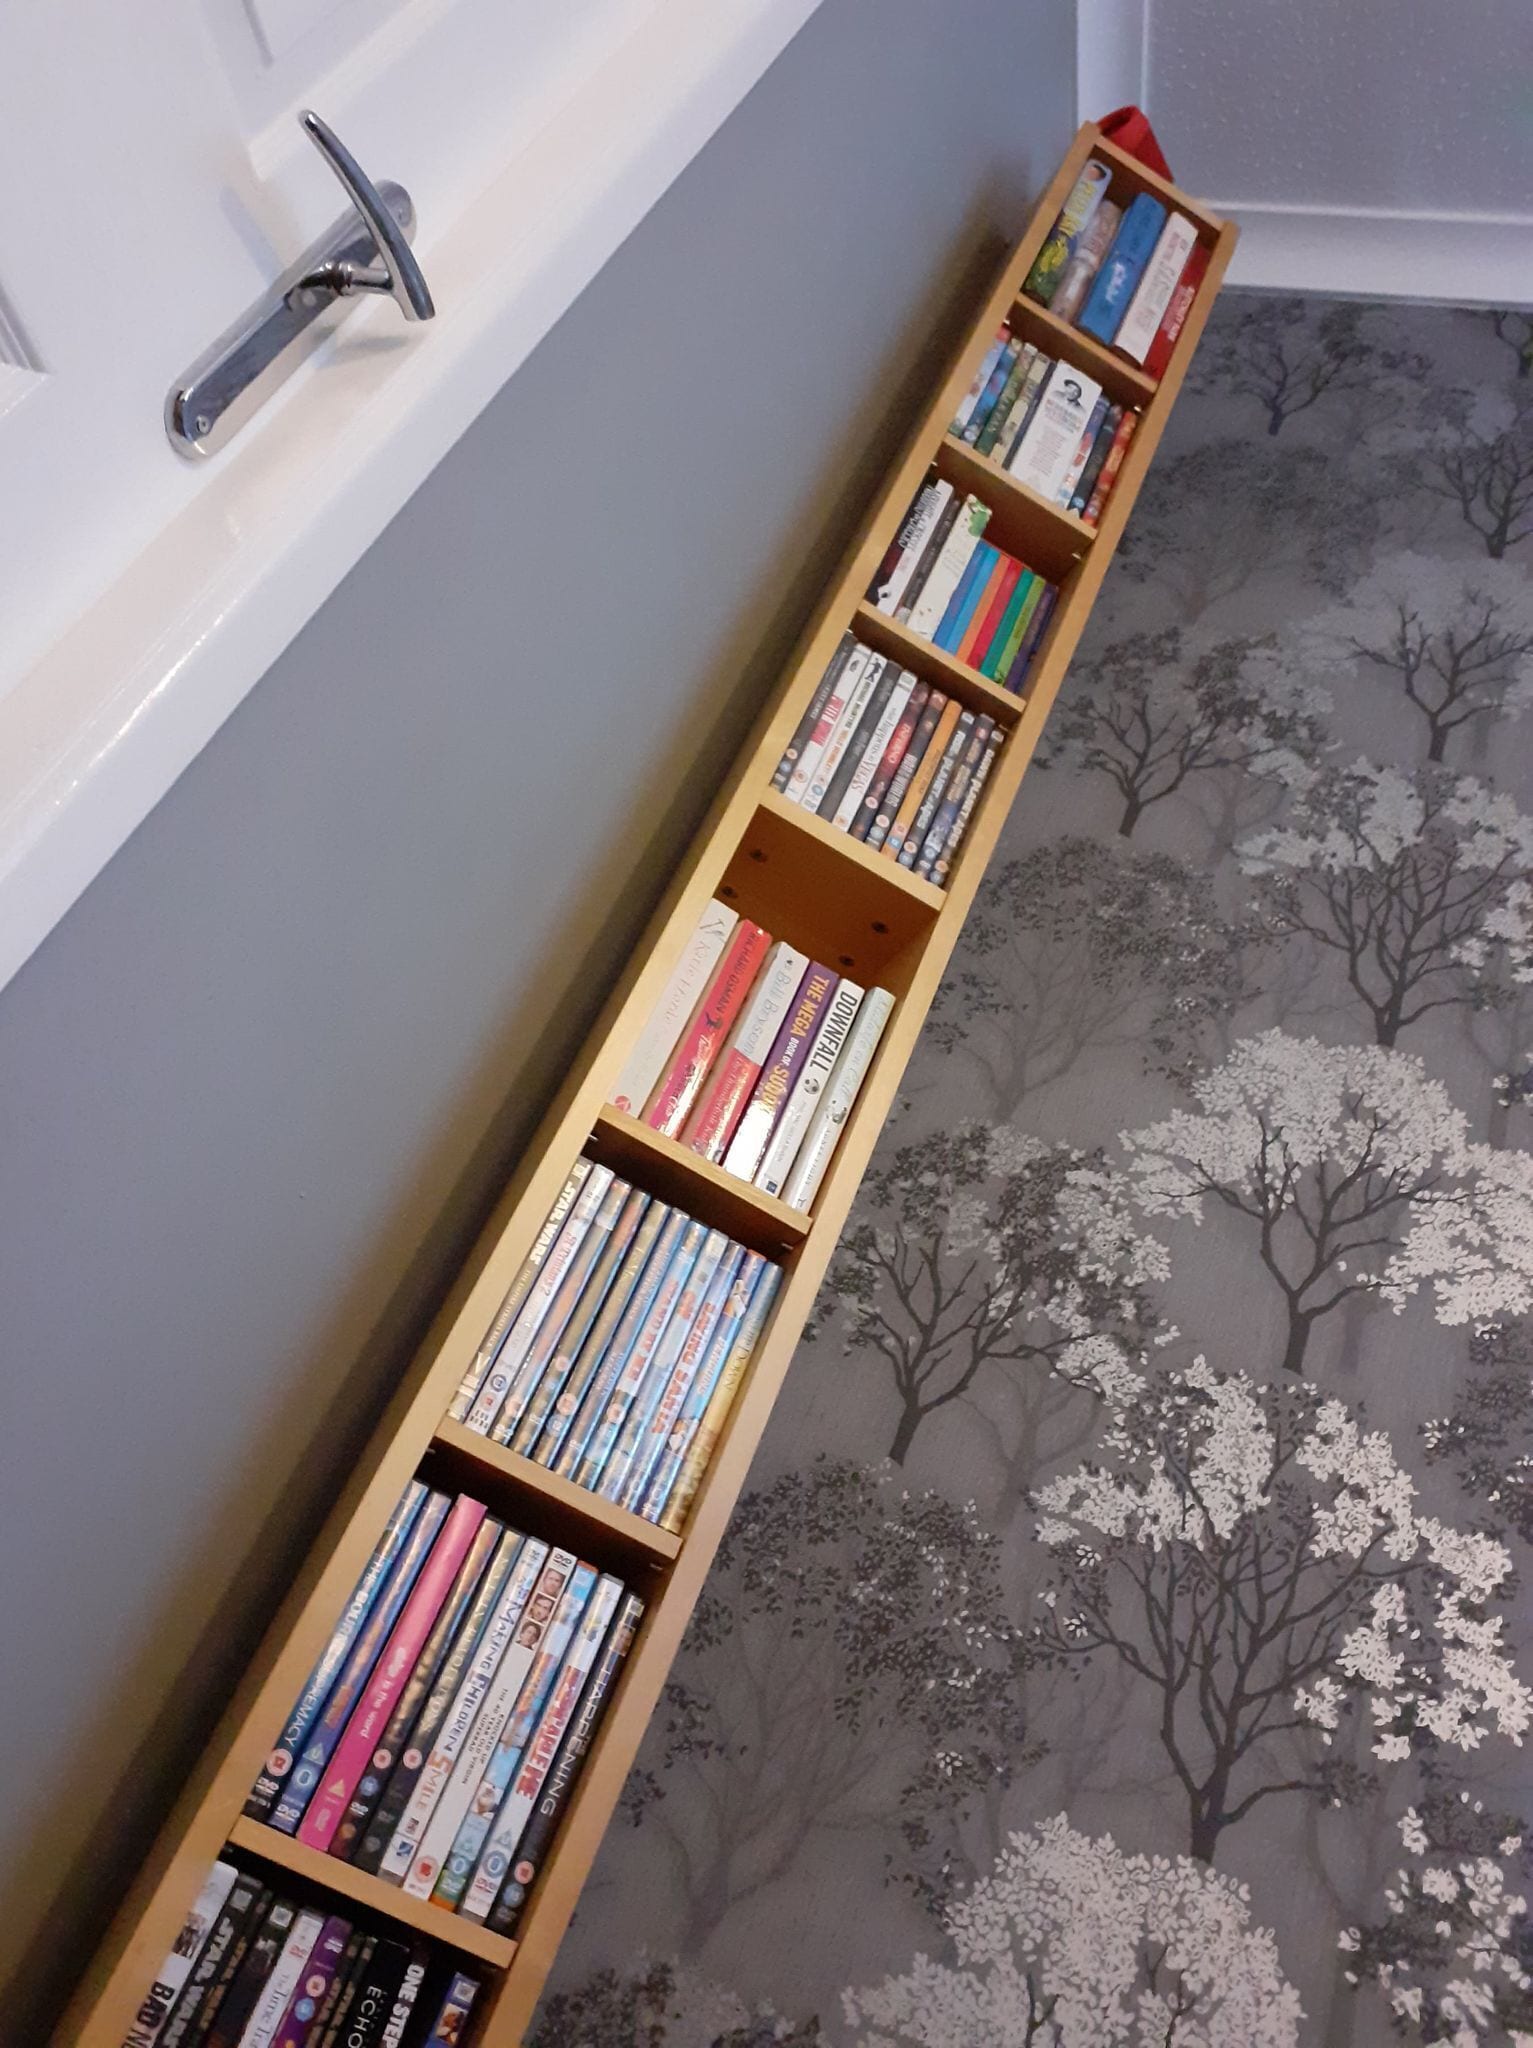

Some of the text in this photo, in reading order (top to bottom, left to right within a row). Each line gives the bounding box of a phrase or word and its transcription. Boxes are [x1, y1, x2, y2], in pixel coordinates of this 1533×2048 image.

[867, 717, 894, 756] happens
[849, 757, 875, 794] VEGAS
[899, 752, 918, 773] WAR
[929, 756, 954, 797] PLANET
[975, 748, 995, 779] DAWN
[883, 773, 908, 807] WORLDS
[957, 778, 981, 819] PLANET
[915, 800, 934, 829] APES
[945, 818, 964, 847] APES
[684, 939, 711, 978] Katie
[731, 931, 759, 975] RICHARD
[714, 973, 740, 1014] OSMAN
[767, 970, 793, 999] Bill
[806, 973, 829, 1002] THE
[741, 997, 780, 1057] Bryson
[789, 998, 819, 1038] MEGA
[808, 990, 859, 1074] DOWNFALL
[780, 1054, 792, 1066] OF
[783, 1036, 799, 1058] BOOK
[548, 1180, 578, 1224] STAR
[528, 1220, 557, 1265] WARS
[538, 1286, 551, 1296] 2
[649, 1300, 718, 1437] SAVING SANTA
[695, 1336, 728, 1397] PENGUINS
[476, 1597, 522, 1672] MAKING
[282, 1653, 338, 1747] SUPREMACY
[372, 1690, 389, 1710] the
[439, 1669, 490, 1755] CHILDREN
[359, 1708, 380, 1739] word
[467, 1712, 488, 1752] SUPERBAD
[478, 1713, 505, 1764] KNOCKED UP
[483, 1716, 495, 1736] YEAR
[539, 1667, 612, 1816] HAPPENING
[474, 1737, 486, 1754] OLD
[409, 1750, 455, 1815] SMILE
[514, 1764, 544, 1801] ME
[160, 1916, 237, 2048] STAR WARS
[197, 1936, 249, 2031] STAR WARS
[135, 1979, 175, 2031] BAD
[260, 1988, 287, 2027] Time
[344, 1983, 382, 2048] ECHO
[378, 1961, 426, 2048] ONE STEP
